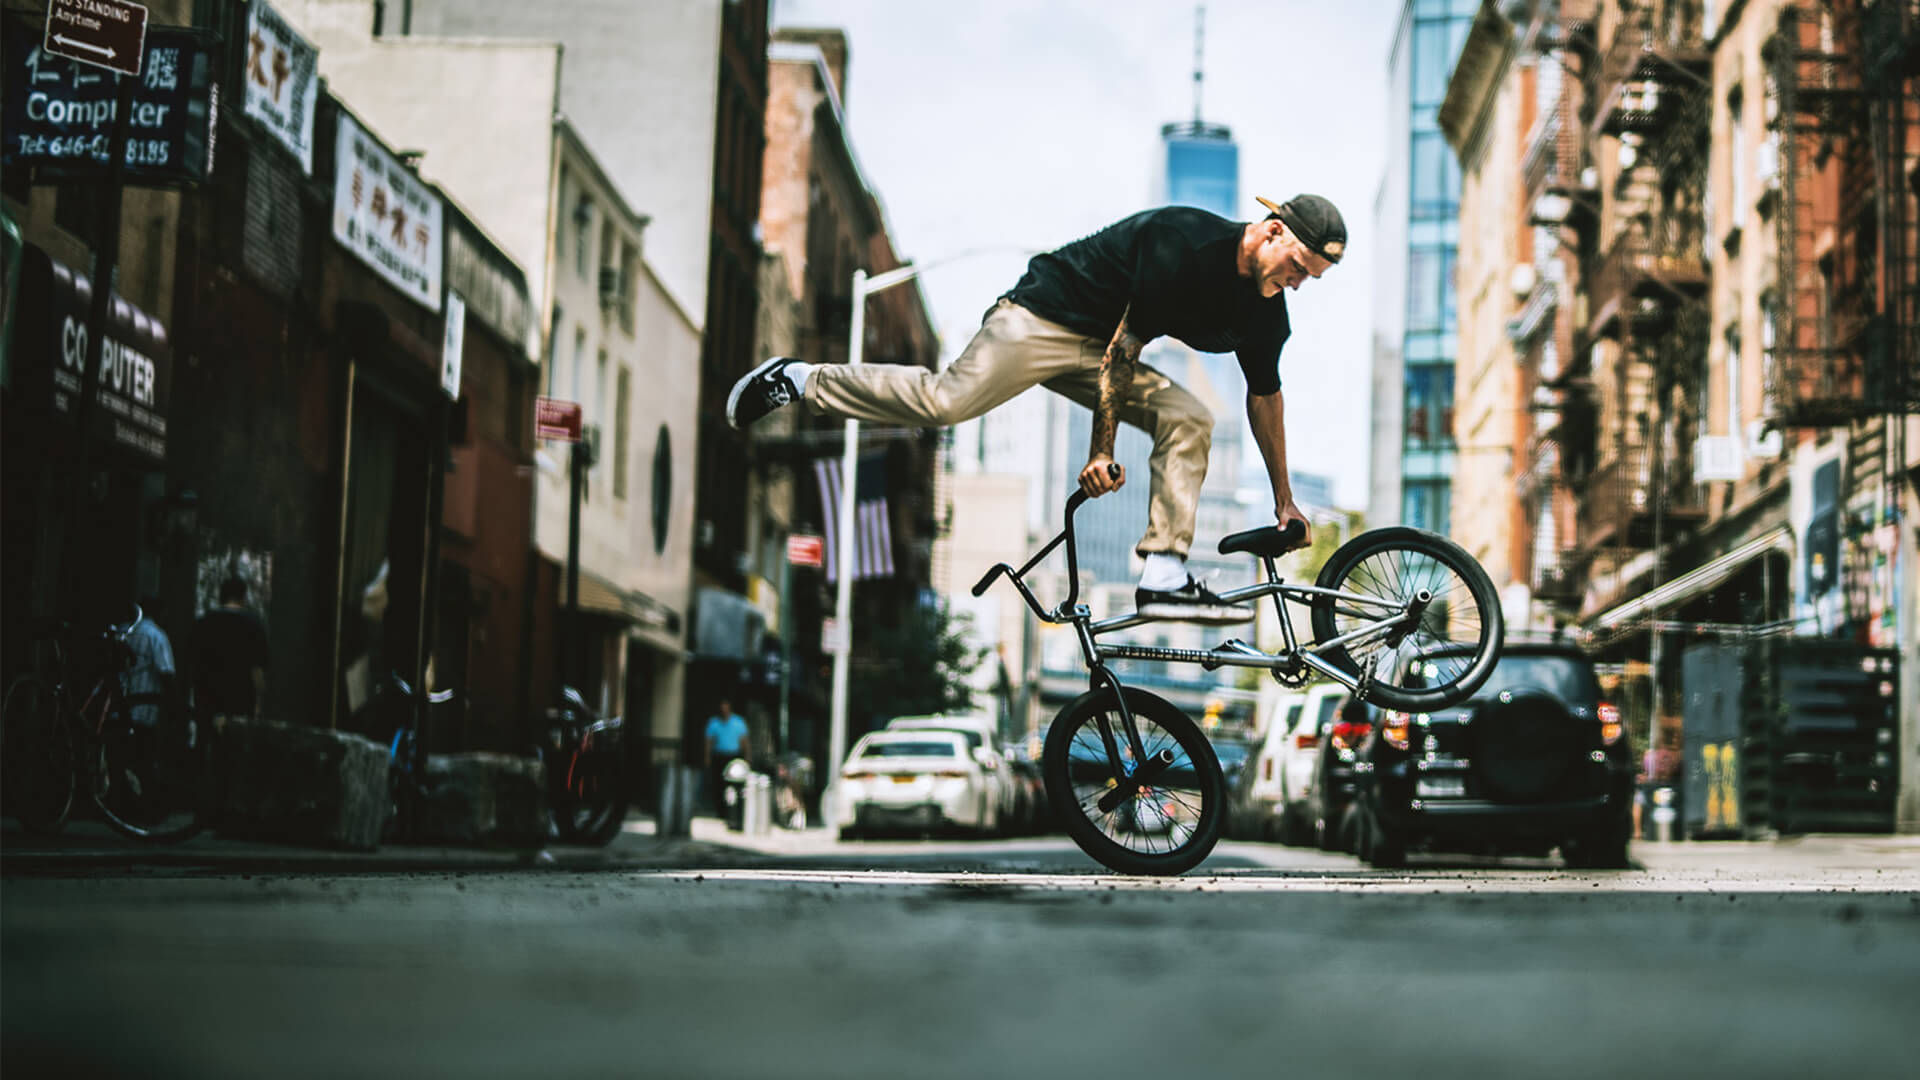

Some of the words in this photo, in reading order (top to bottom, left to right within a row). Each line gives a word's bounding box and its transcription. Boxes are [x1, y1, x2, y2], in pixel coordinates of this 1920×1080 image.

[56, 7, 102, 31] Anytime
[75, 0, 131, 23] STANDING
[62, 315, 155, 407] COPUTER
